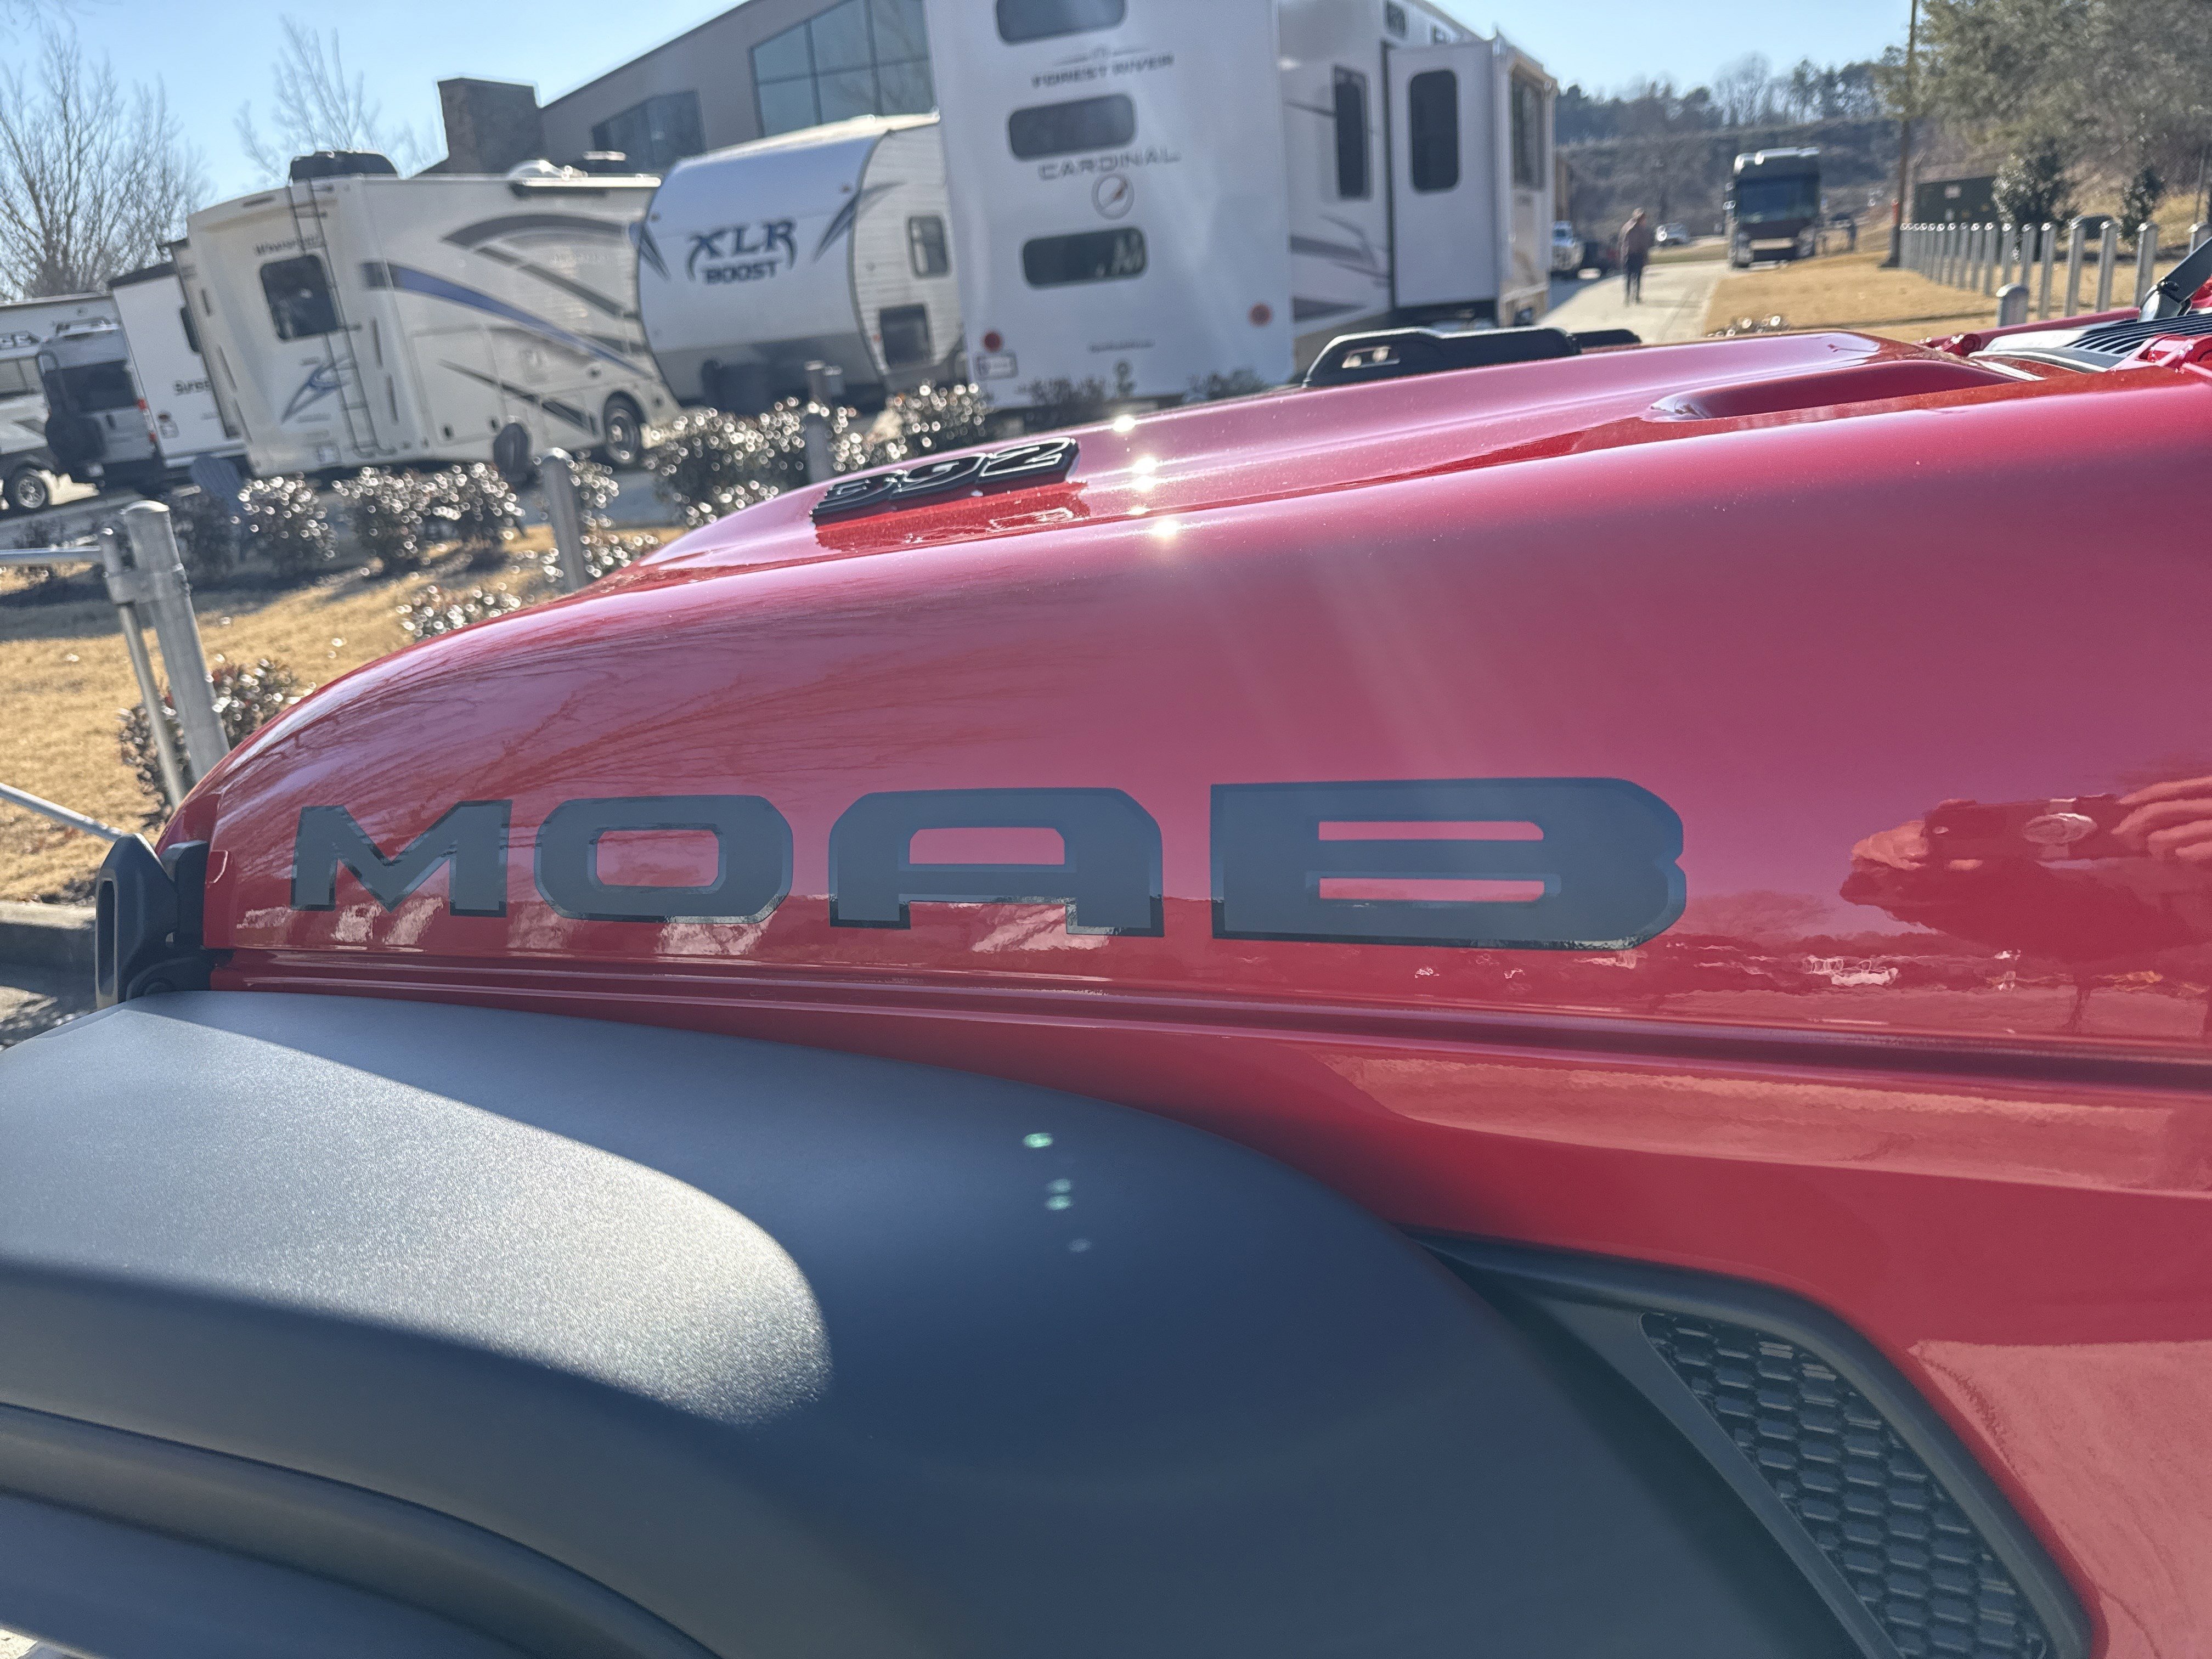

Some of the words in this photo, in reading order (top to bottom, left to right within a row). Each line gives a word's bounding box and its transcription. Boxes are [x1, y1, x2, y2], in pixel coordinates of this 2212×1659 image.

[1038, 146, 1181, 180] CARDINAL
[686, 217, 797, 281] XLR
[702, 259, 781, 285] BOOST
[811, 437, 1079, 519] 392
[290, 777, 1686, 952] MOAB
